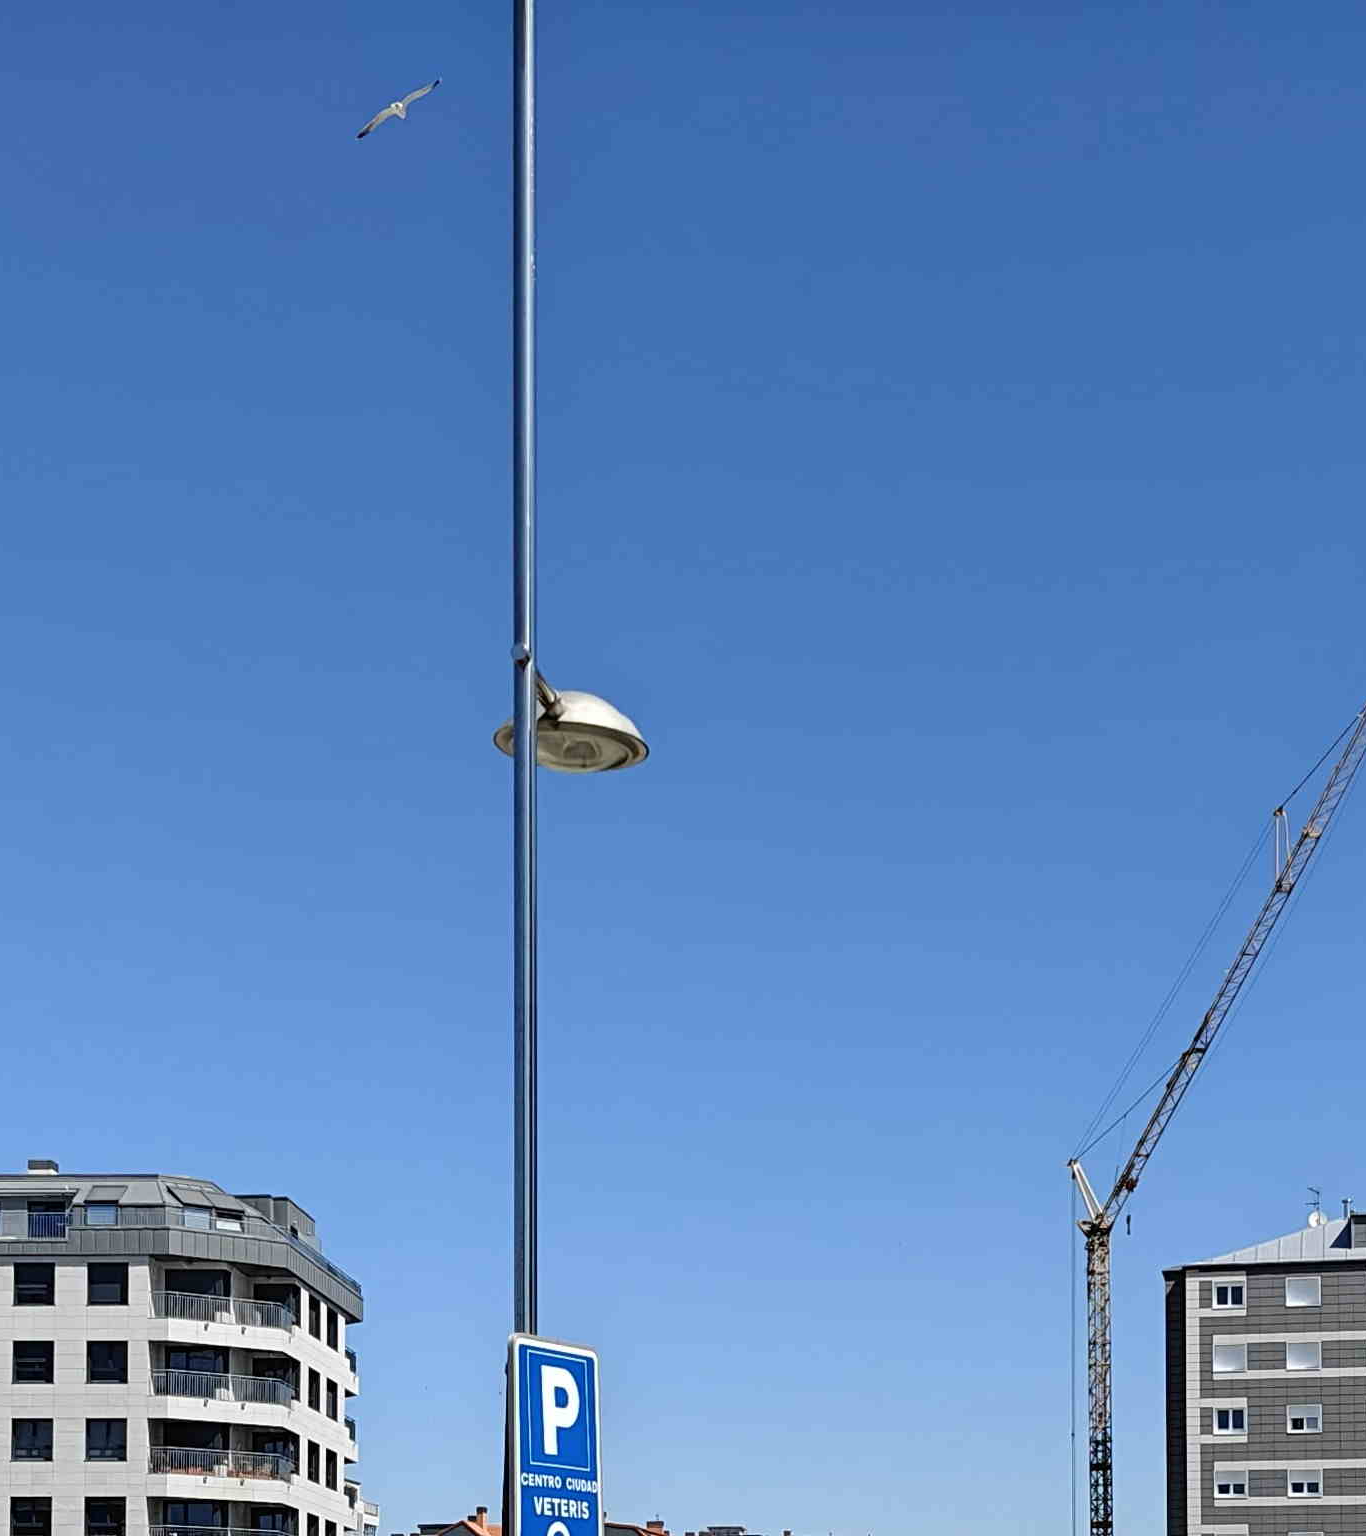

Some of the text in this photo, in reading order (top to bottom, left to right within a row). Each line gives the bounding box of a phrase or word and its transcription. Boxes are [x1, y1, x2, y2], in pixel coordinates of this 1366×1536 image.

[541, 1364, 580, 1455] P
[521, 1472, 599, 1494] CENTRO CIUDAD
[533, 1496, 590, 1520] VETERIS
